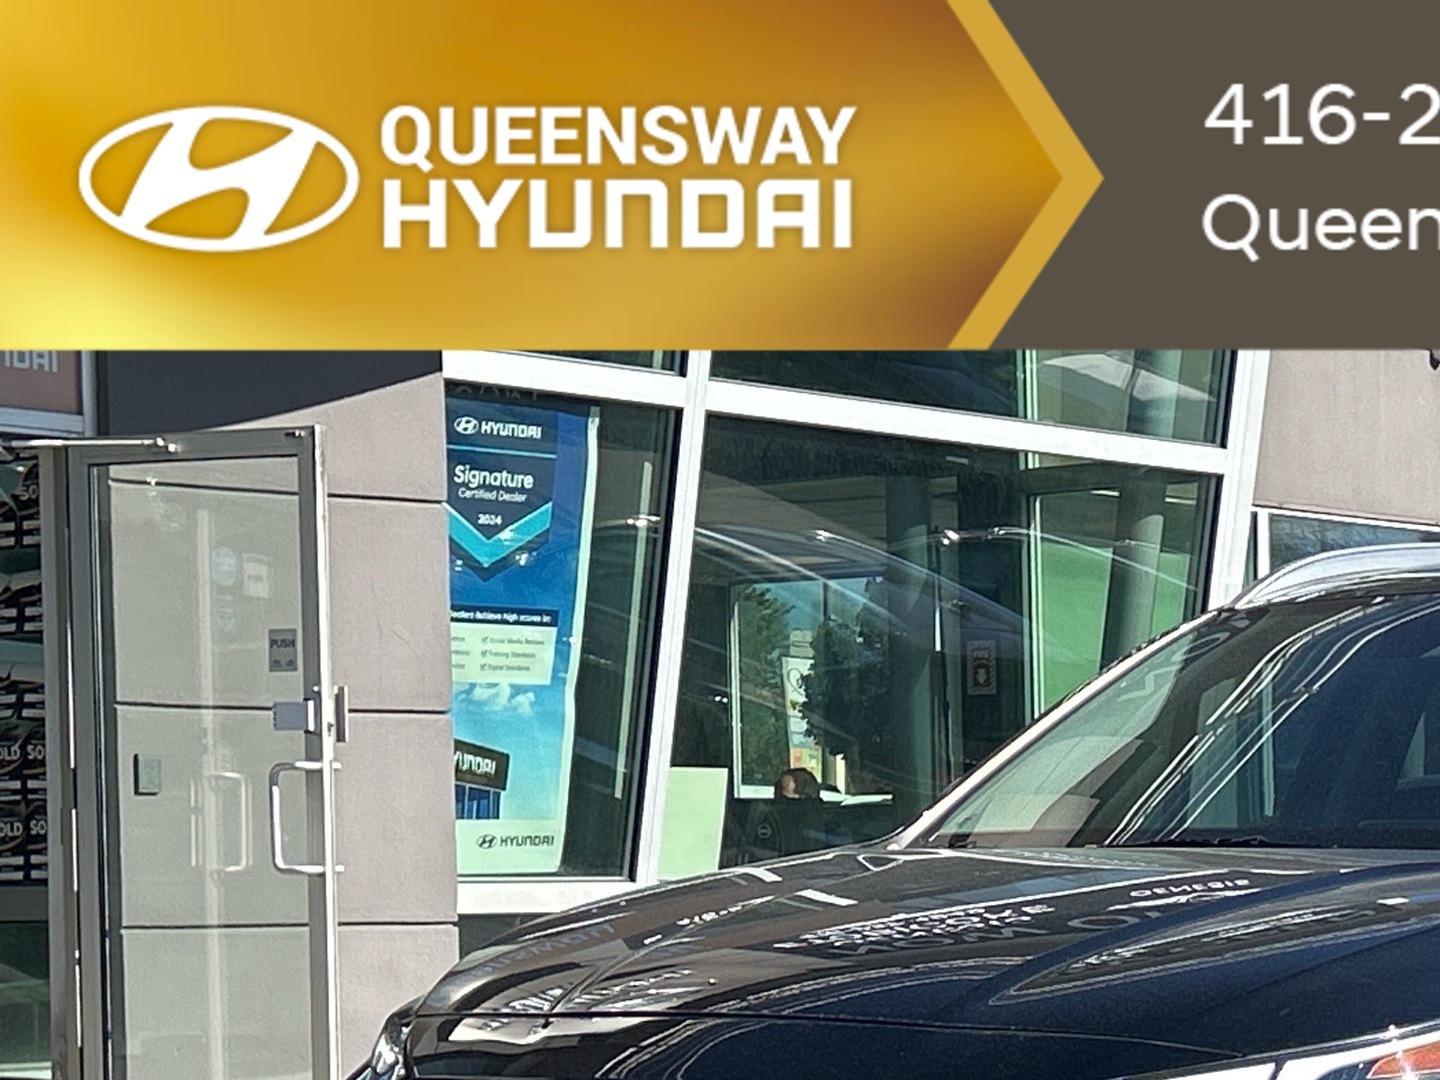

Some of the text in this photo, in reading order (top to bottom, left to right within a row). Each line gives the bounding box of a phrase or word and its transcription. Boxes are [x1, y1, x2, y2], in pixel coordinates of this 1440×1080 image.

[480, 421, 542, 439] HYUNDAI
[453, 465, 534, 489] Signature
[270, 638, 296, 650] PUSH
[500, 835, 555, 846] HYUNDAI
